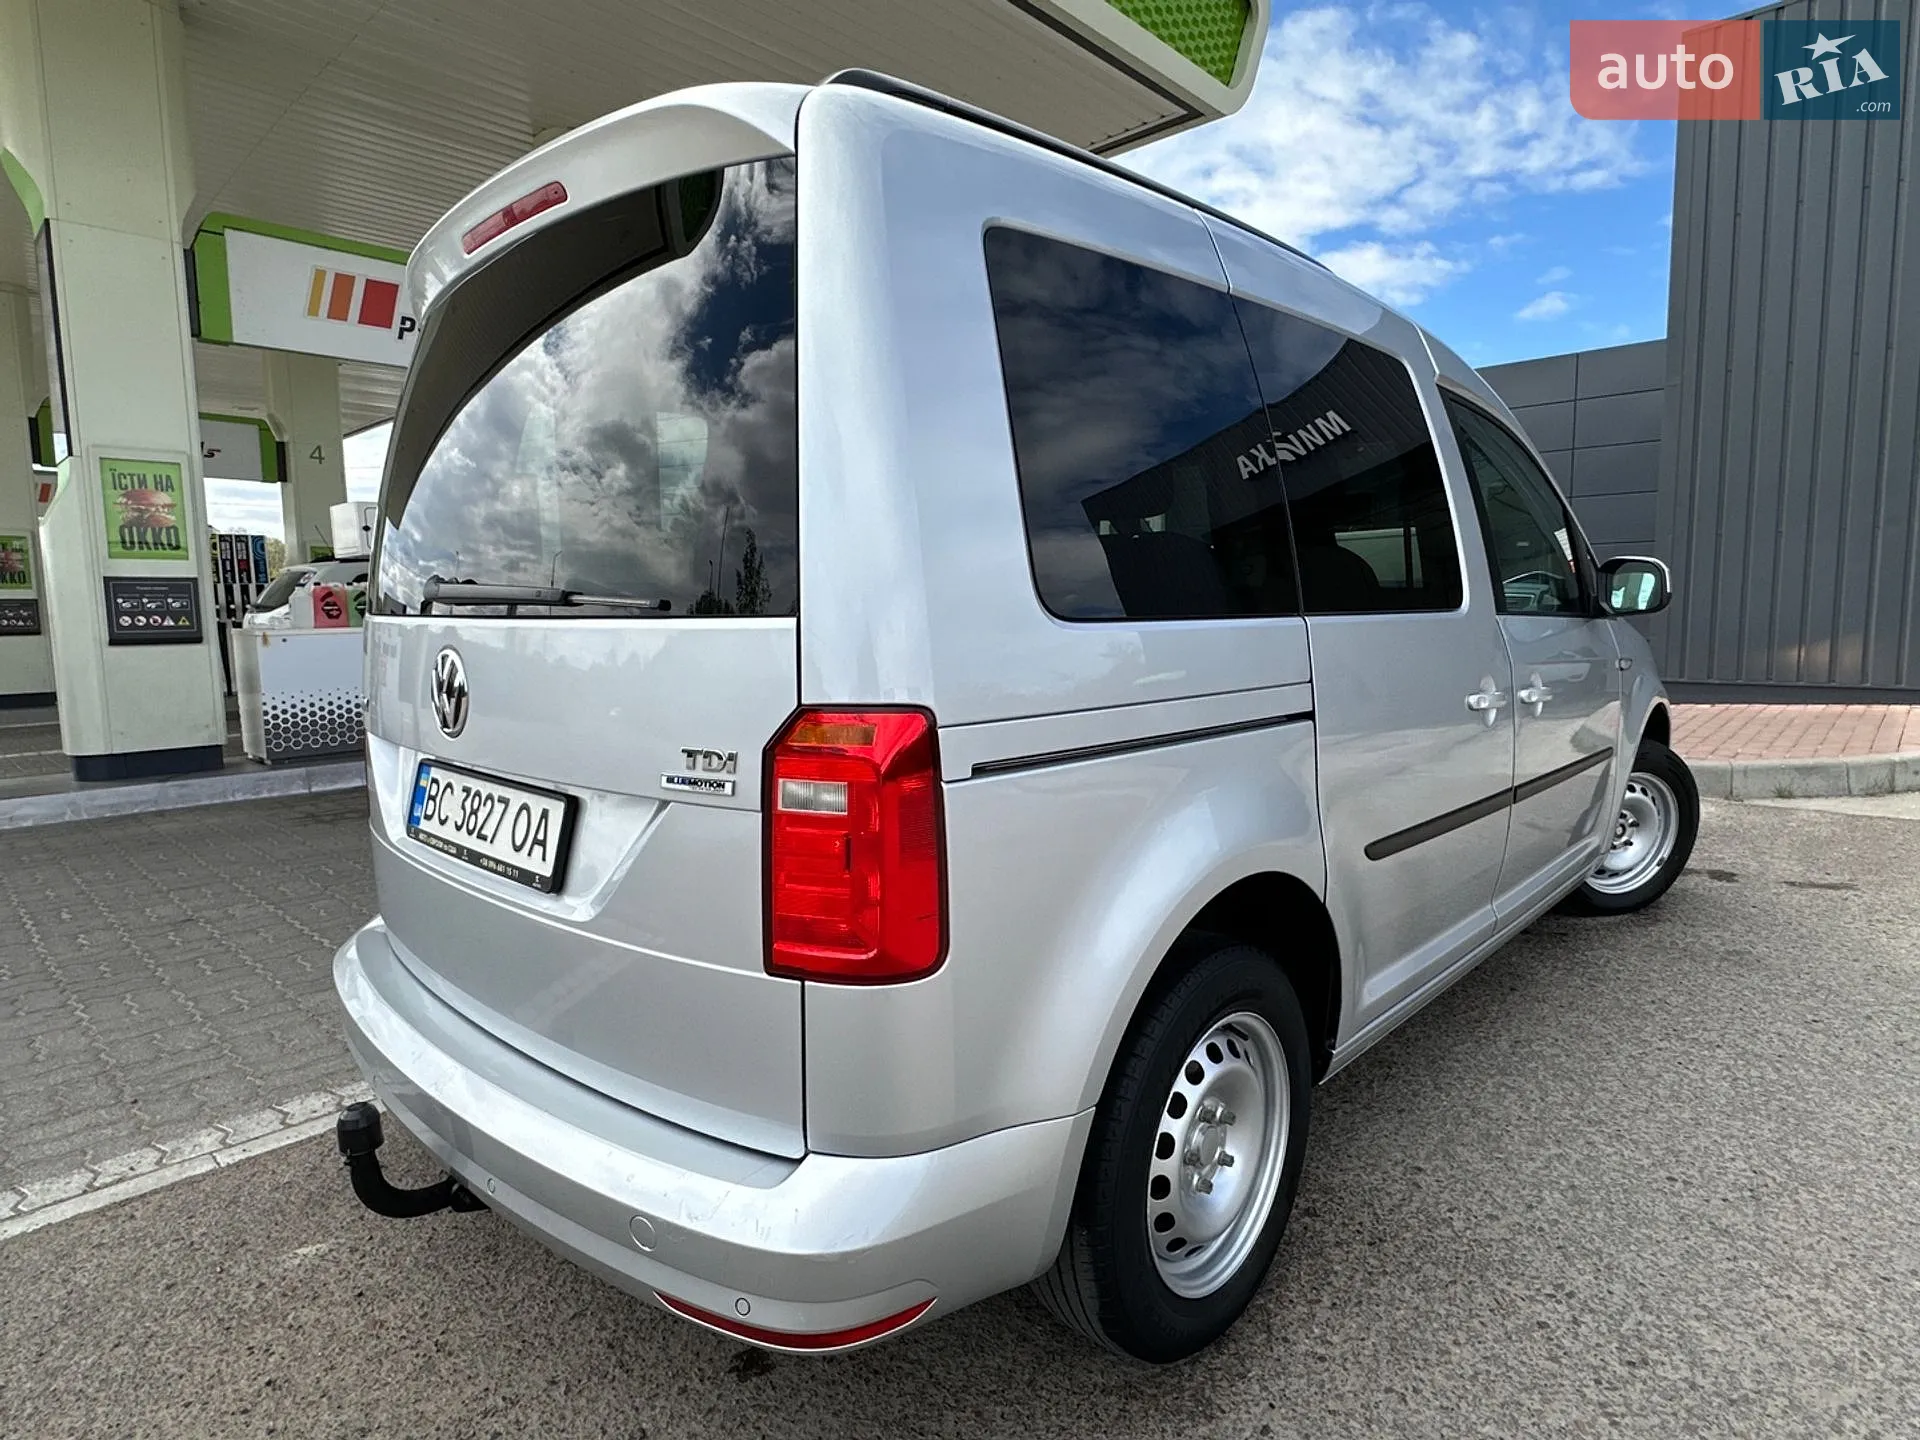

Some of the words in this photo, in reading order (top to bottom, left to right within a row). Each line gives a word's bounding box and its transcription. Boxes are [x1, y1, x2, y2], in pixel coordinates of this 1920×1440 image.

[309, 444, 326, 464] 4
[109, 468, 148, 491] ЇСТИ
[153, 474, 176, 493] НА
[680, 746, 738, 774] TDI
[454, 785, 511, 845] 3827
